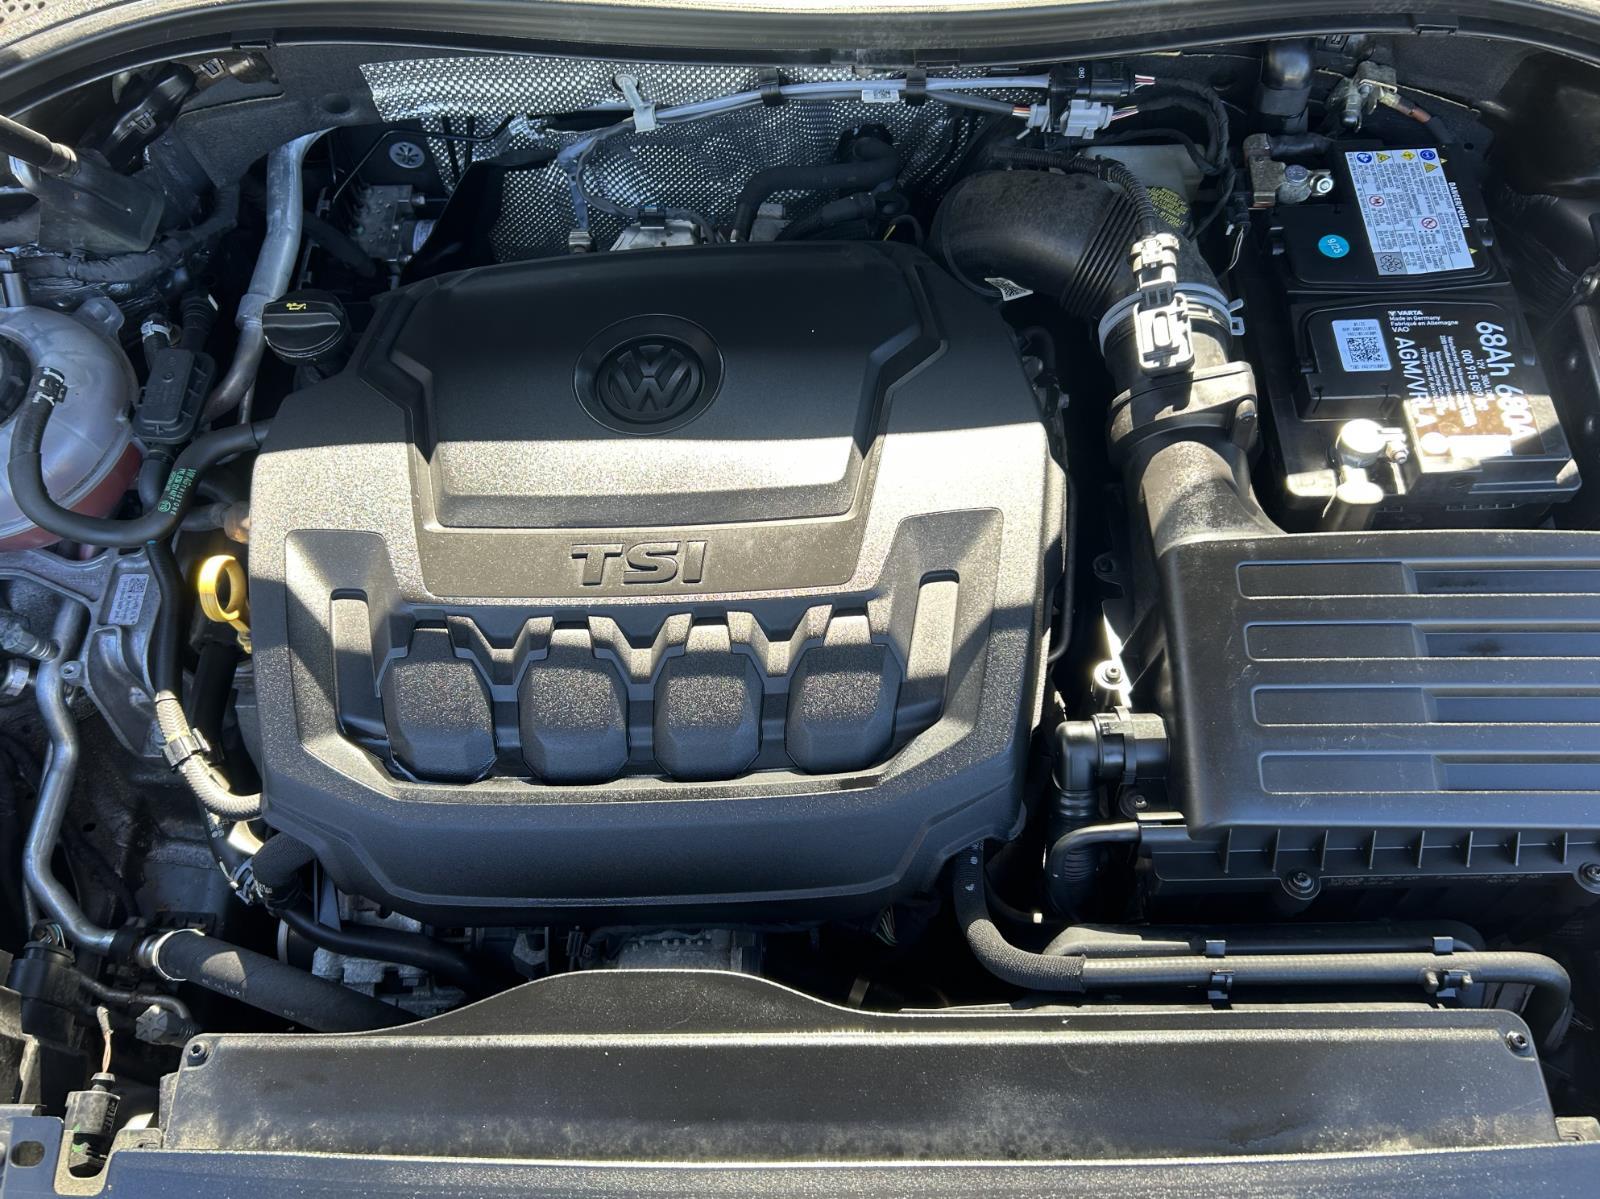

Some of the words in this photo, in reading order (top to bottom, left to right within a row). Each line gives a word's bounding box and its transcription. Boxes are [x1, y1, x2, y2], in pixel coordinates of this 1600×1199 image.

[1448, 182, 1470, 228] DANGER/POISON
[1461, 350, 1474, 364] 000
[1475, 322, 1516, 377] 68Ah
[1394, 337, 1438, 427] AGM/VRLA
[1465, 366, 1479, 380] 915
[1495, 384, 1537, 441] 680A
[571, 540, 707, 586] TSI
